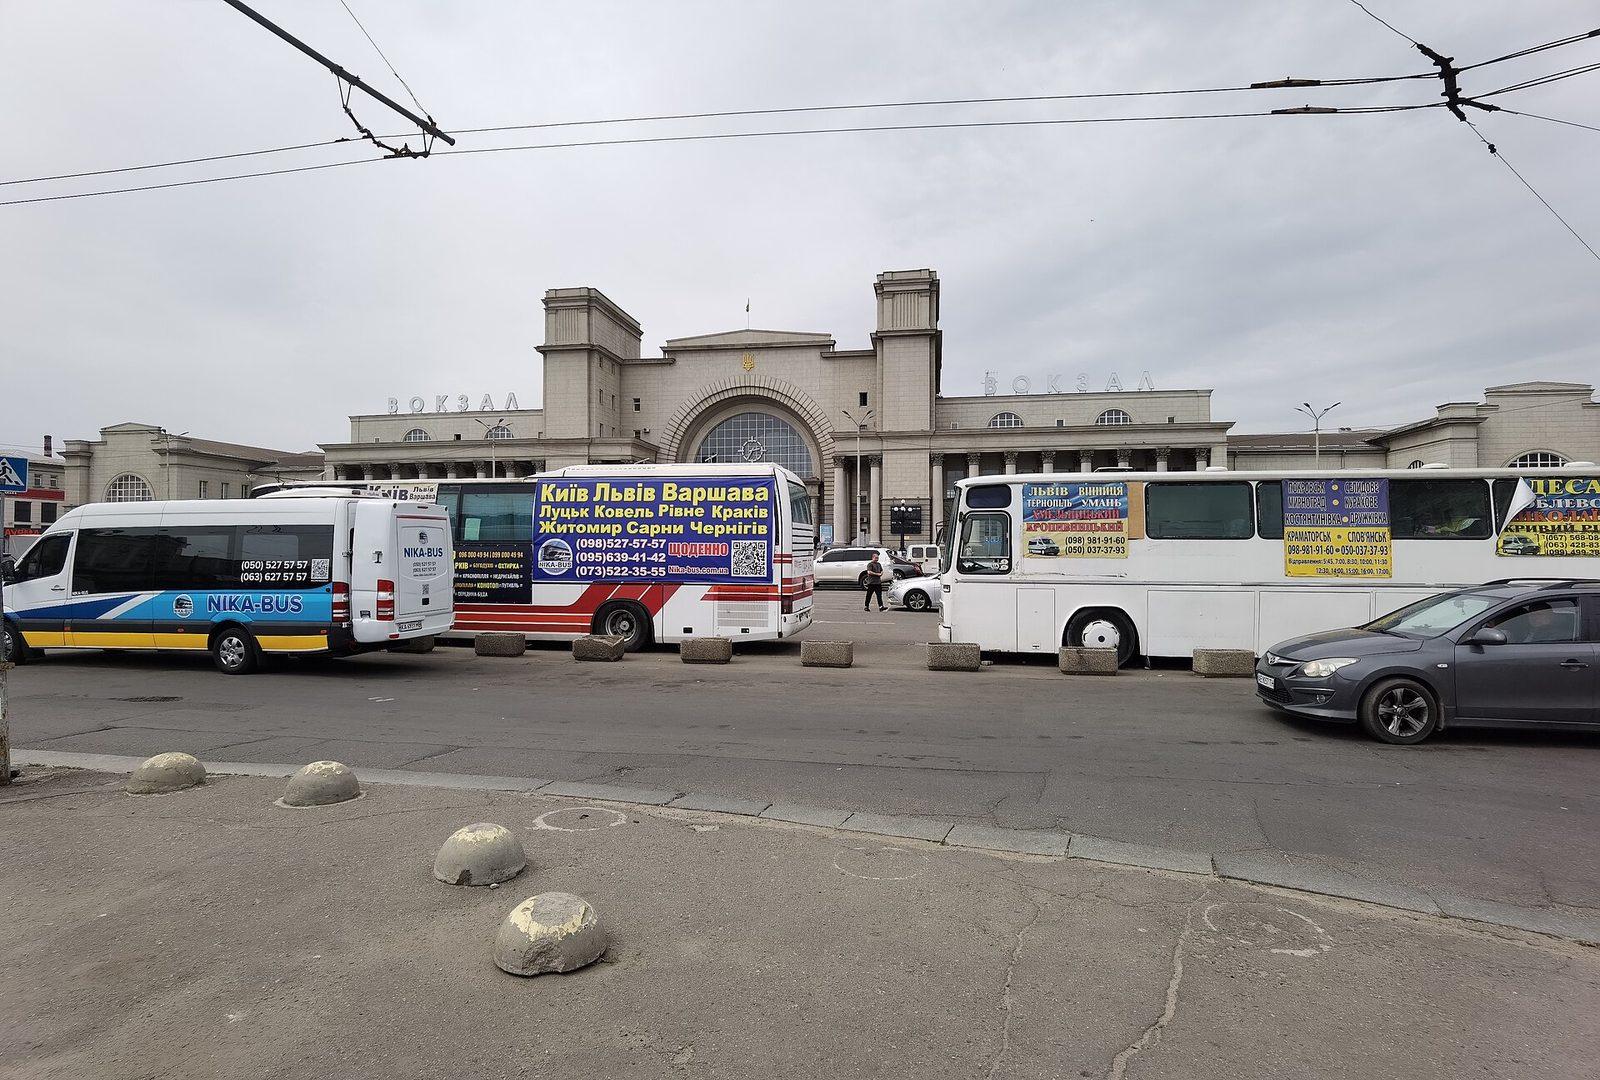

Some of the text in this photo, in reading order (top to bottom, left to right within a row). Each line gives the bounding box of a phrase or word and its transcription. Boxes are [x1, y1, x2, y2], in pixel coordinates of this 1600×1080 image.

[984, 371, 1155, 396] ВОКЗАЛ
[387, 392, 519, 413] ВОКЗАЛ
[1029, 486, 1123, 496] ЛЬВІВ ВІННИЦЯ
[1288, 481, 1379, 496] ПОКРОВСЬК СЕЛИДОВЕ
[1530, 479, 1600, 497] ДЕСА
[540, 483, 769, 506] Київ Львів Варшава
[1027, 499, 1122, 507] ТЕРНОПІЛЬ УМАНЬ
[1288, 496, 1326, 511] МИРНОГРАД
[539, 504, 769, 521] Луцьк Ковель Рівне Краків
[1285, 512, 1388, 526] КОСТЯНТИНІВКА ДРУЖКІВКА
[539, 521, 768, 537] Житомир Сарни Чернігів
[1504, 523, 1575, 533] КРИВИЙ
[1065, 537, 1085, 545] (098)
[1288, 531, 1387, 542] КРАМАТОРСЬК СЛОВ'ЯНСЬК
[576, 539, 666, 550] (098)527-57-57
[668, 542, 728, 557] ЩОДЕННО
[404, 548, 443, 558] NIKA-BUS
[1065, 546, 1085, 555] (050)
[1288, 546, 1388, 555] 098-981-91-60 050-037-37-93
[576, 552, 666, 563] (095)639-41-42
[241, 560, 308, 570] (050) 527 57 57
[668, 566, 729, 574] Nika-bus.com.ua
[240, 572, 307, 582] (063) 627 57 57
[576, 566, 666, 578] (073)522-35-55
[208, 594, 304, 613] NIKA-BUS
